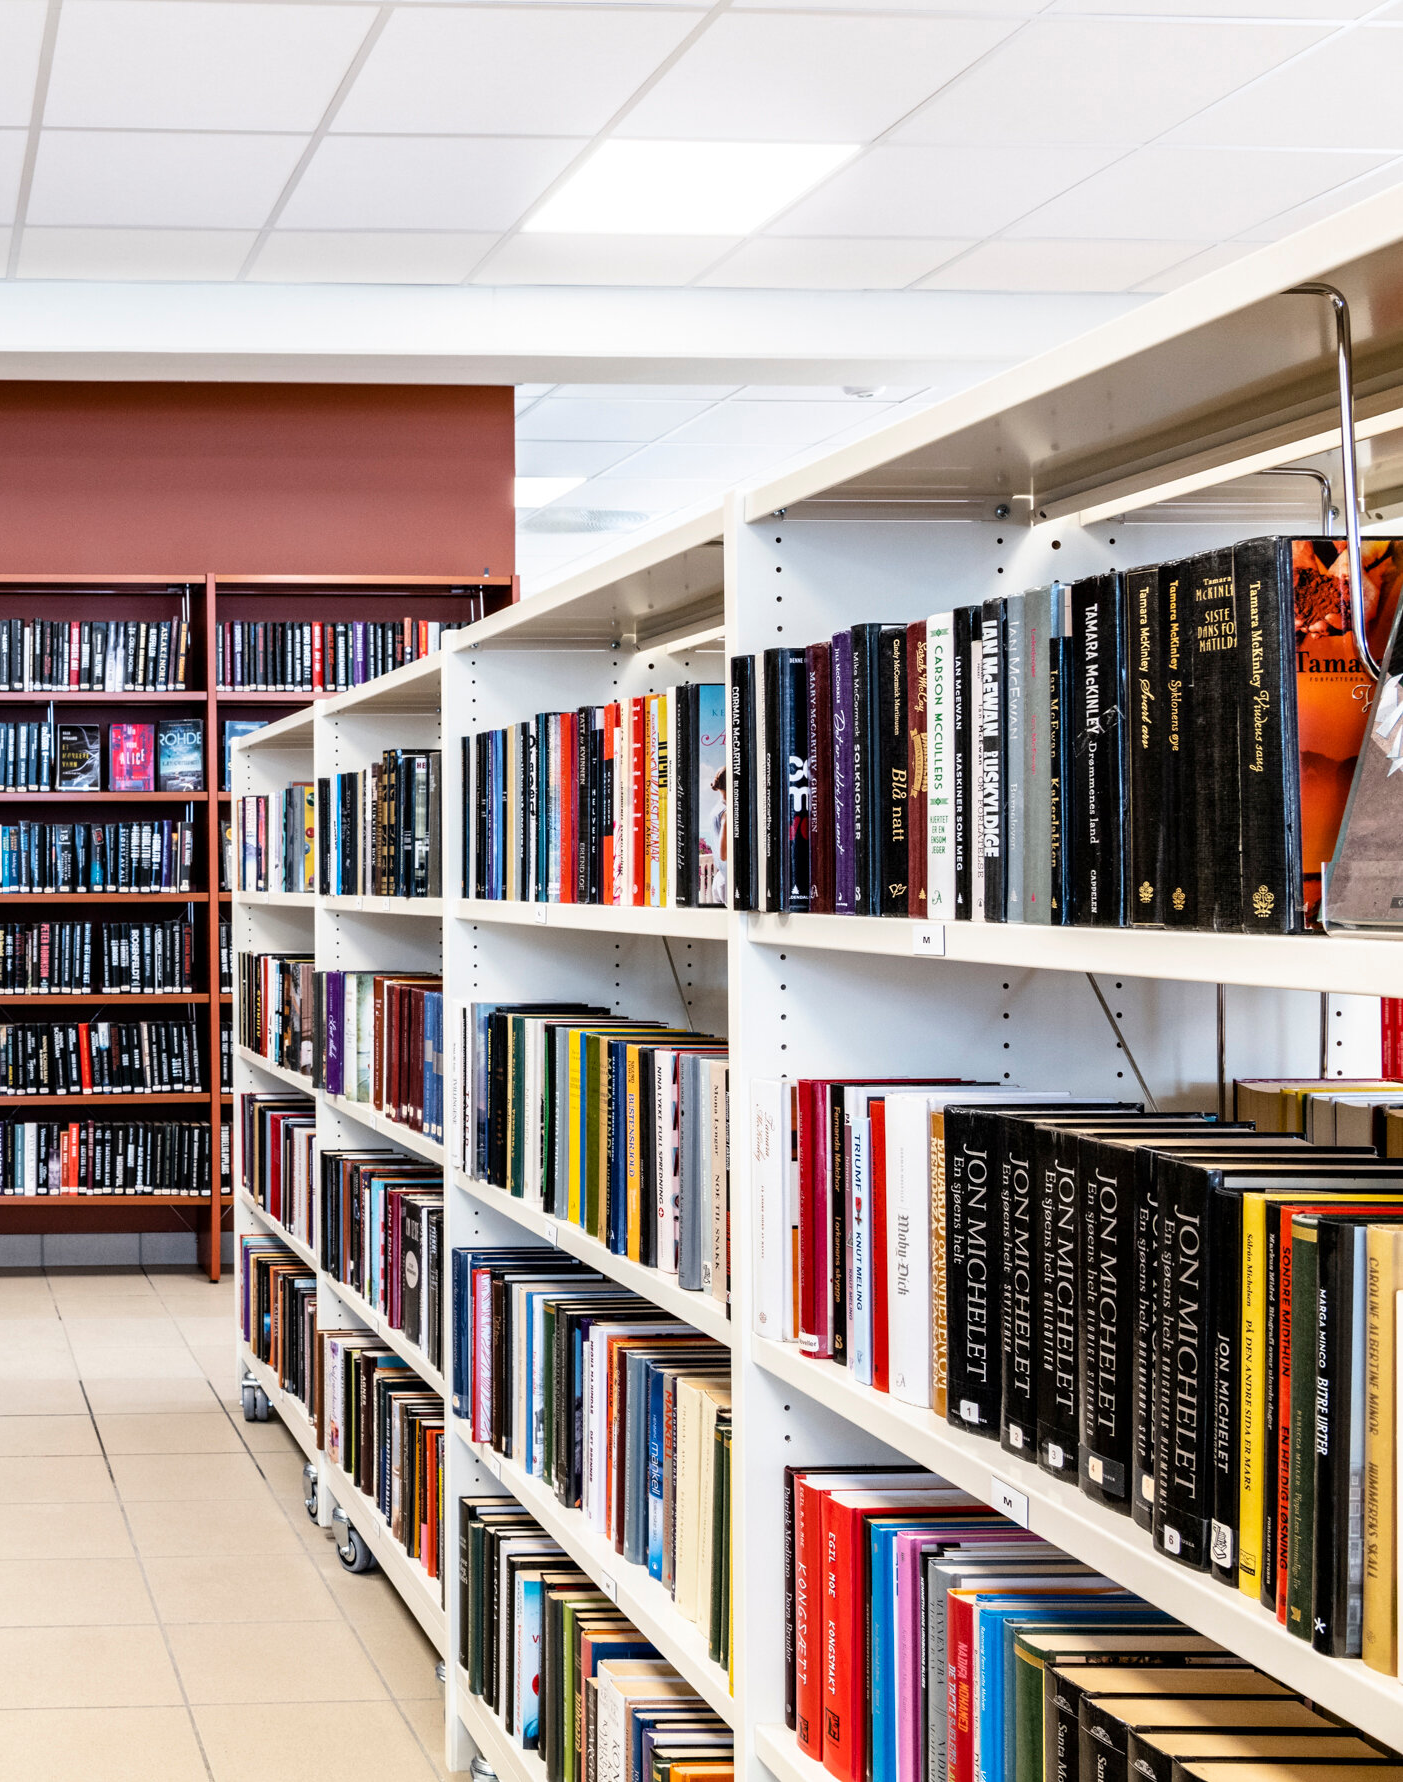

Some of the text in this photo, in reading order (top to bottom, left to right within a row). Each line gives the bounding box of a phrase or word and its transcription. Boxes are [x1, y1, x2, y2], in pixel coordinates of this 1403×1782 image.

[1139, 586, 1150, 625] Tamara
[1202, 576, 1232, 586] Tamara
[1008, 621, 1020, 651] IAN
[1205, 608, 1230, 624] SISTE
[158, 626, 168, 682] ASLAK NORE
[852, 652, 860, 676] Mike
[933, 645, 944, 705] CARSON
[1138, 627, 1150, 672] McKinley
[1168, 580, 1182, 751] Tamara McKinley Syklonens øye
[1249, 581, 1269, 773] Tamara McKinley Vindens sang
[732, 686, 741, 725] CORMAC
[853, 679, 861, 737] McCormack
[954, 679, 962, 730] McEWAN
[1008, 656, 1020, 740] McEWAN
[1085, 604, 1100, 844] TAMARA McKINLEY Drømmenes land
[1139, 678, 1155, 724] Svart
[119, 749, 145, 765] ALICE
[159, 731, 202, 746] ROHDE
[732, 727, 741, 775] McCARTHY
[891, 768, 907, 842] Blå natt
[955, 815, 963, 848] SOM
[930, 835, 947, 844] ENSOM
[955, 850, 963, 871] MEG
[131, 929, 140, 980] ROSENFELDT
[922, 936, 931, 944] M
[854, 1132, 862, 1191] TRIUMF
[951, 1155, 965, 1265] En sjøens helt
[855, 1230, 863, 1263] KNUT
[895, 1212, 911, 1295] Moby-Dick
[963, 1143, 987, 1383] JON MICHELET
[1009, 1152, 1030, 1398] JON MICHELET
[1054, 1159, 1075, 1415] JON MICHELET
[1095, 1168, 1118, 1437] JON MICHELET
[1174, 1204, 1200, 1500] JON MICHELET
[1317, 1288, 1329, 1456] MARGA MINCO BITRE URTER
[665, 1390, 673, 1461] MANKELL
[1217, 1332, 1230, 1473] JON MICHELET
[1280, 1246, 1291, 1570] SONDRE MIDTHUN EN HELDIG LØSNING
[1367, 1257, 1380, 1579] CAROLINE ALBERTINE MINOR HUMMERENS SKALL
[1003, 1496, 1013, 1508] M
[827, 1532, 837, 1695] EGIL MOE KONGSMAKT
[1058, 1722, 1068, 1762] Santa
